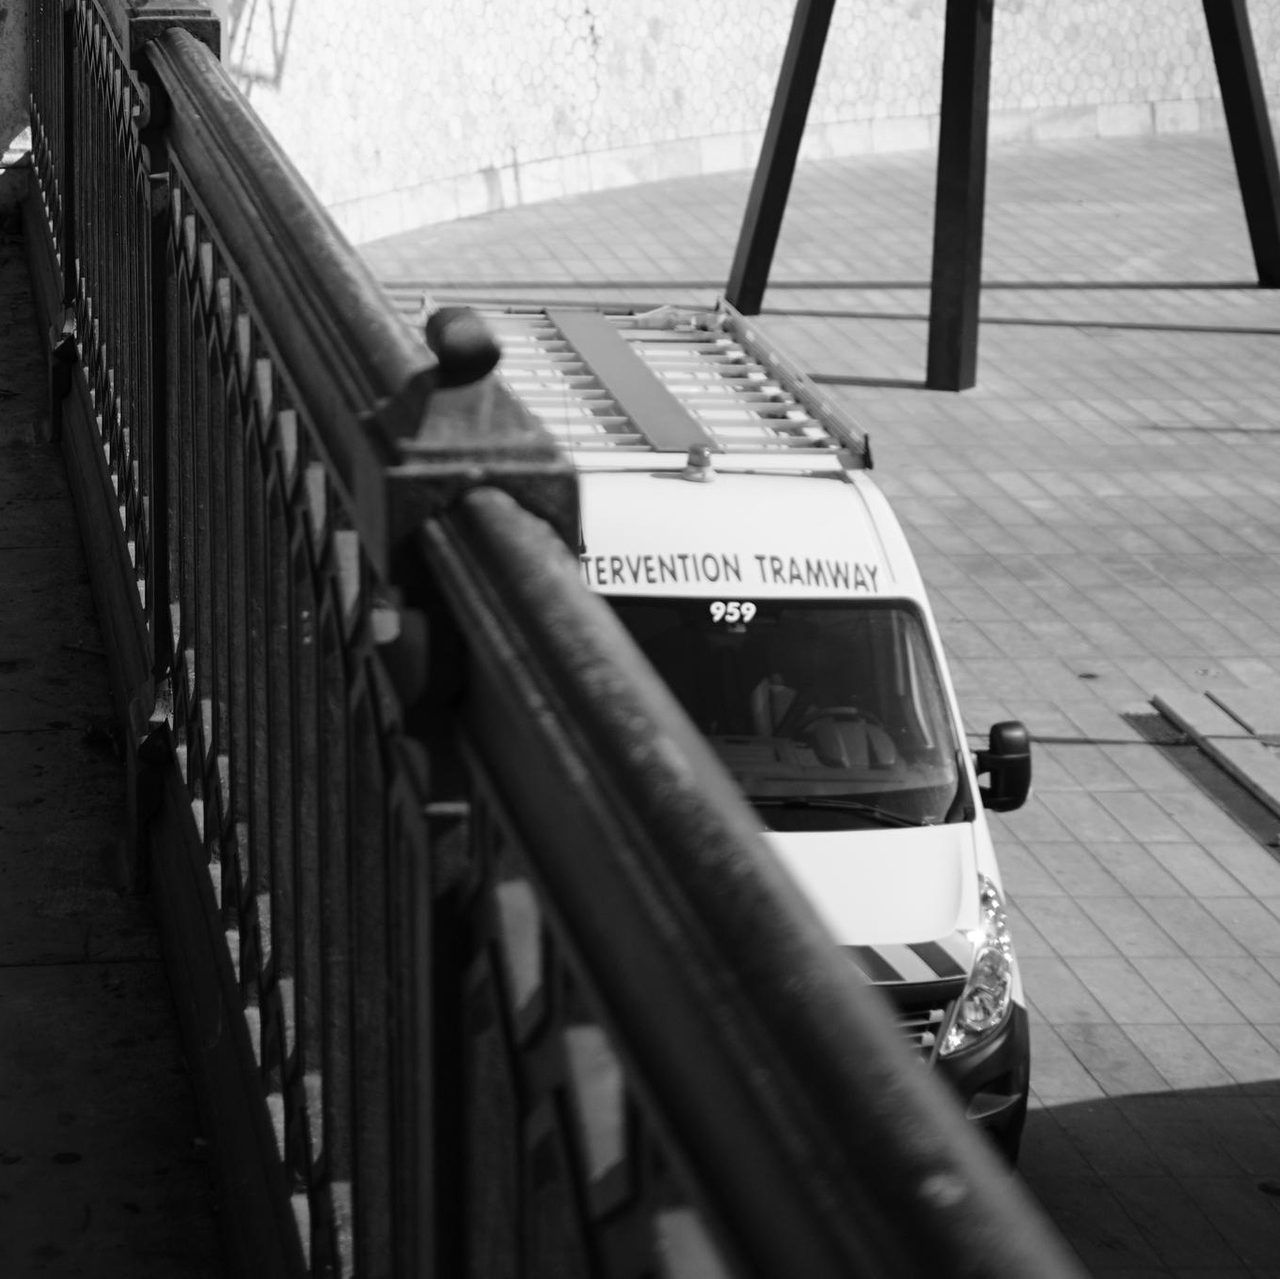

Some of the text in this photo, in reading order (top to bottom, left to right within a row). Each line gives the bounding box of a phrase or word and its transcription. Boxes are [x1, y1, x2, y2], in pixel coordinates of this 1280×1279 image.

[580, 553, 879, 593] TERVENTION TRAMWAY
[709, 601, 758, 623] 959
